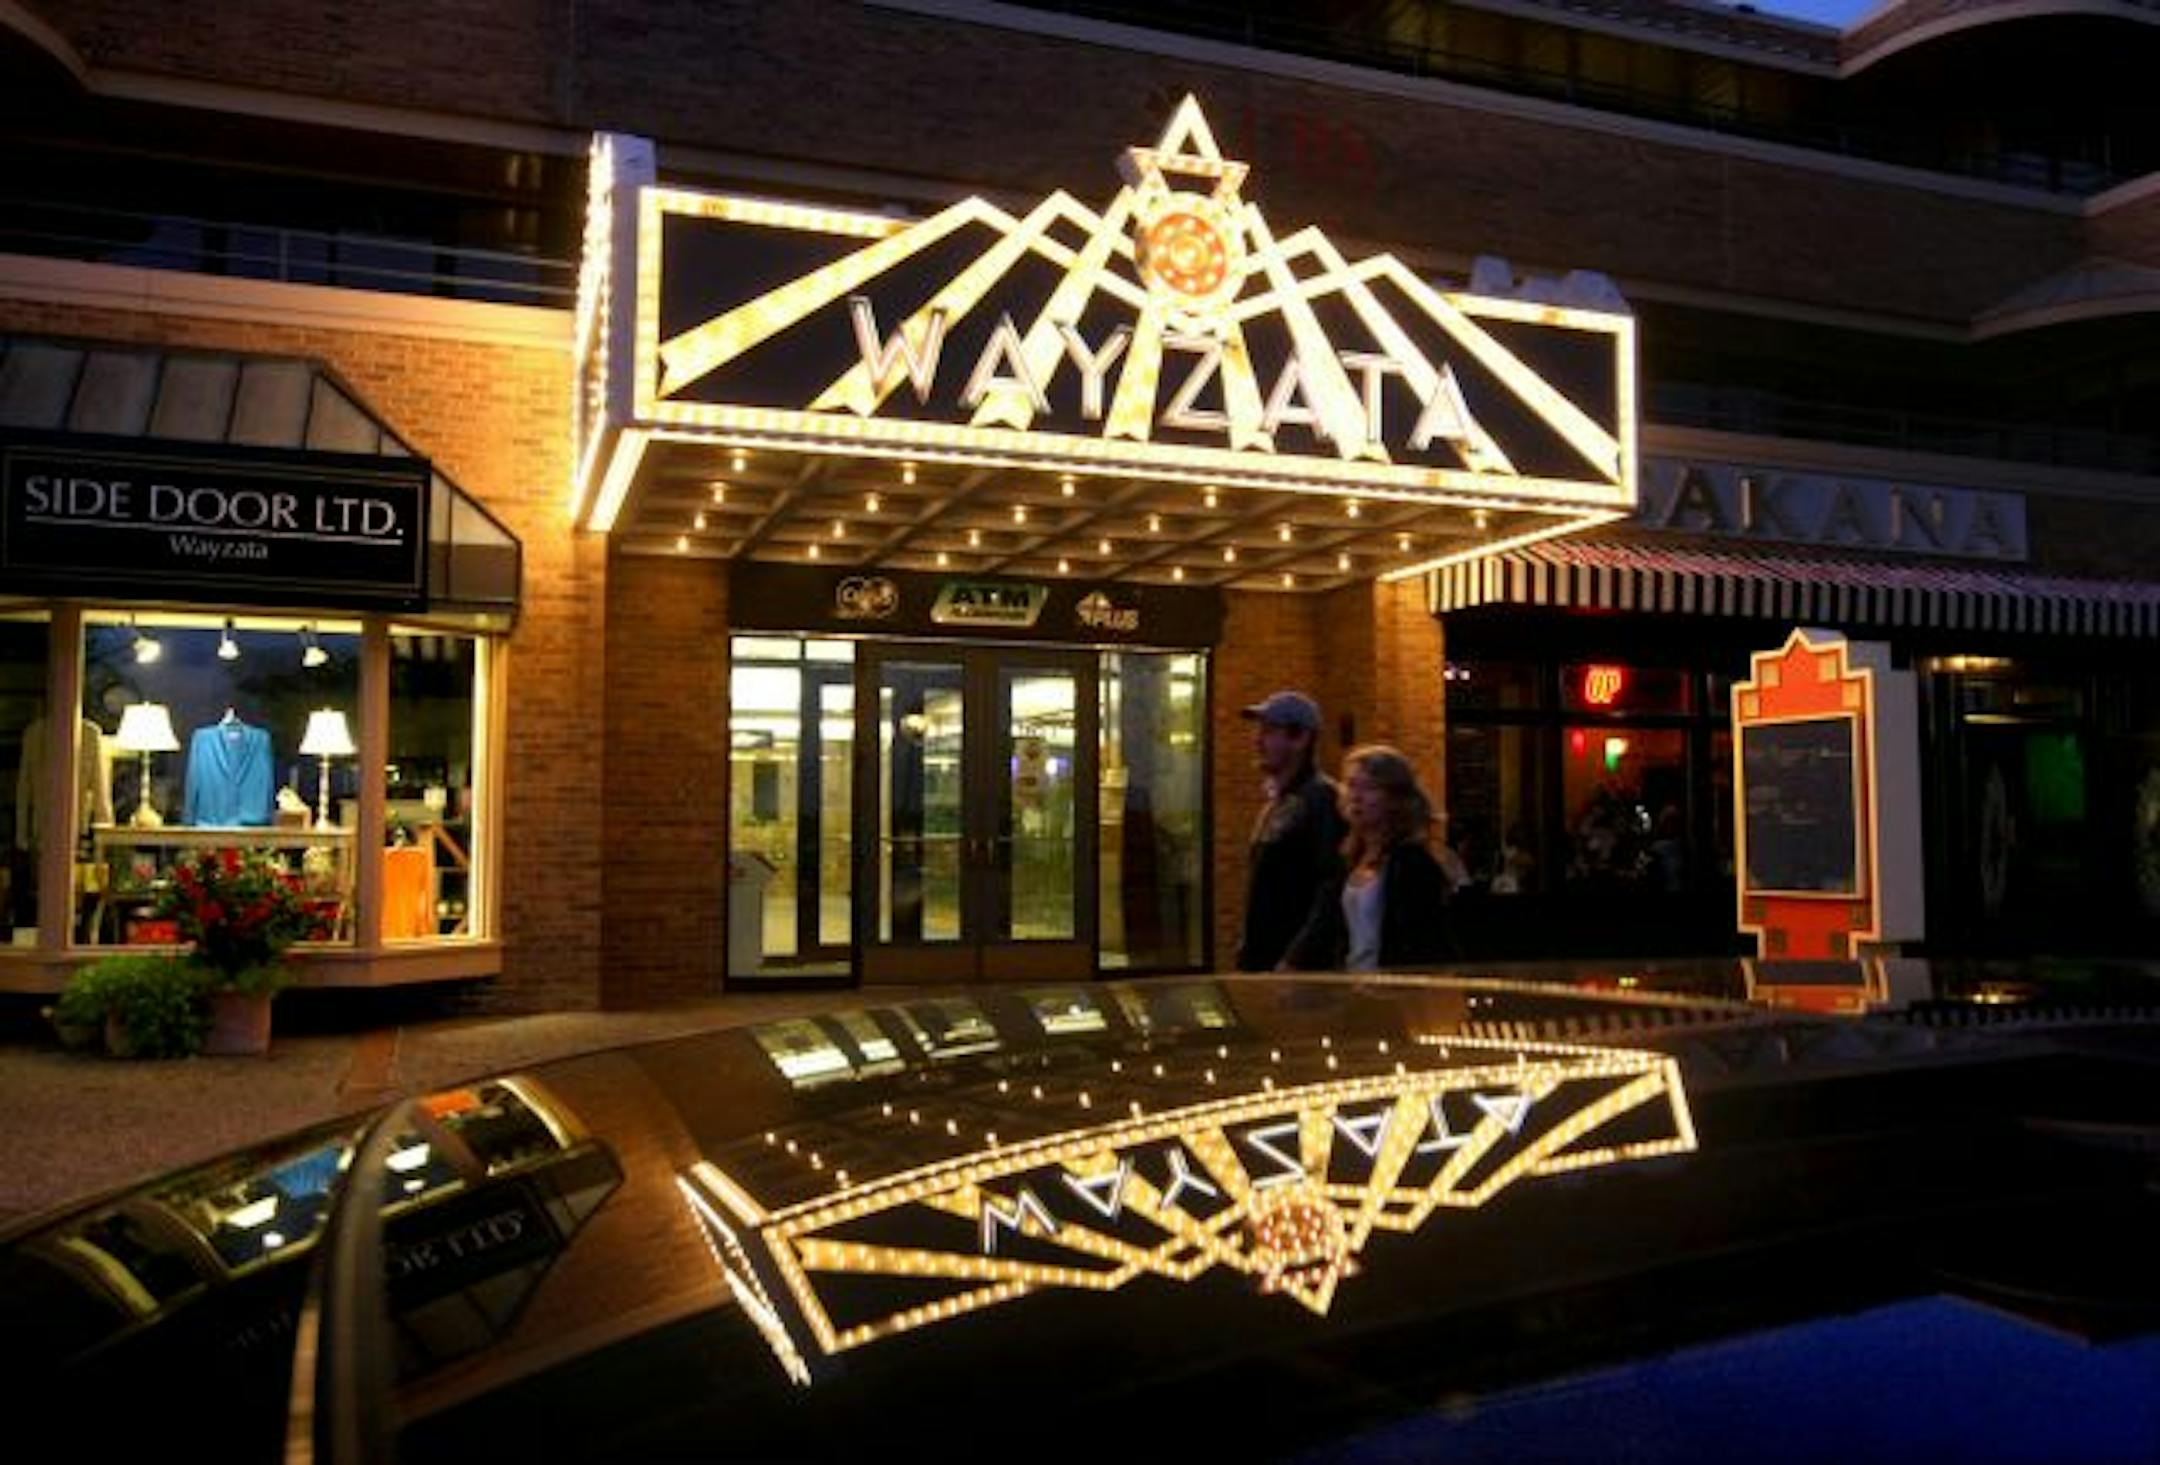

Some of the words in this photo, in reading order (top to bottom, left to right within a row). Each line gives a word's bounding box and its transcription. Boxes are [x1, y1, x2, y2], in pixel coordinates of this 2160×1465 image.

[847, 295, 1477, 452] WAYZATA
[25, 476, 131, 518] SIDE
[148, 484, 299, 530] DOOR
[315, 494, 405, 537] LTD.
[1643, 464, 2016, 554] AKANA
[168, 534, 270, 563] Wayzata
